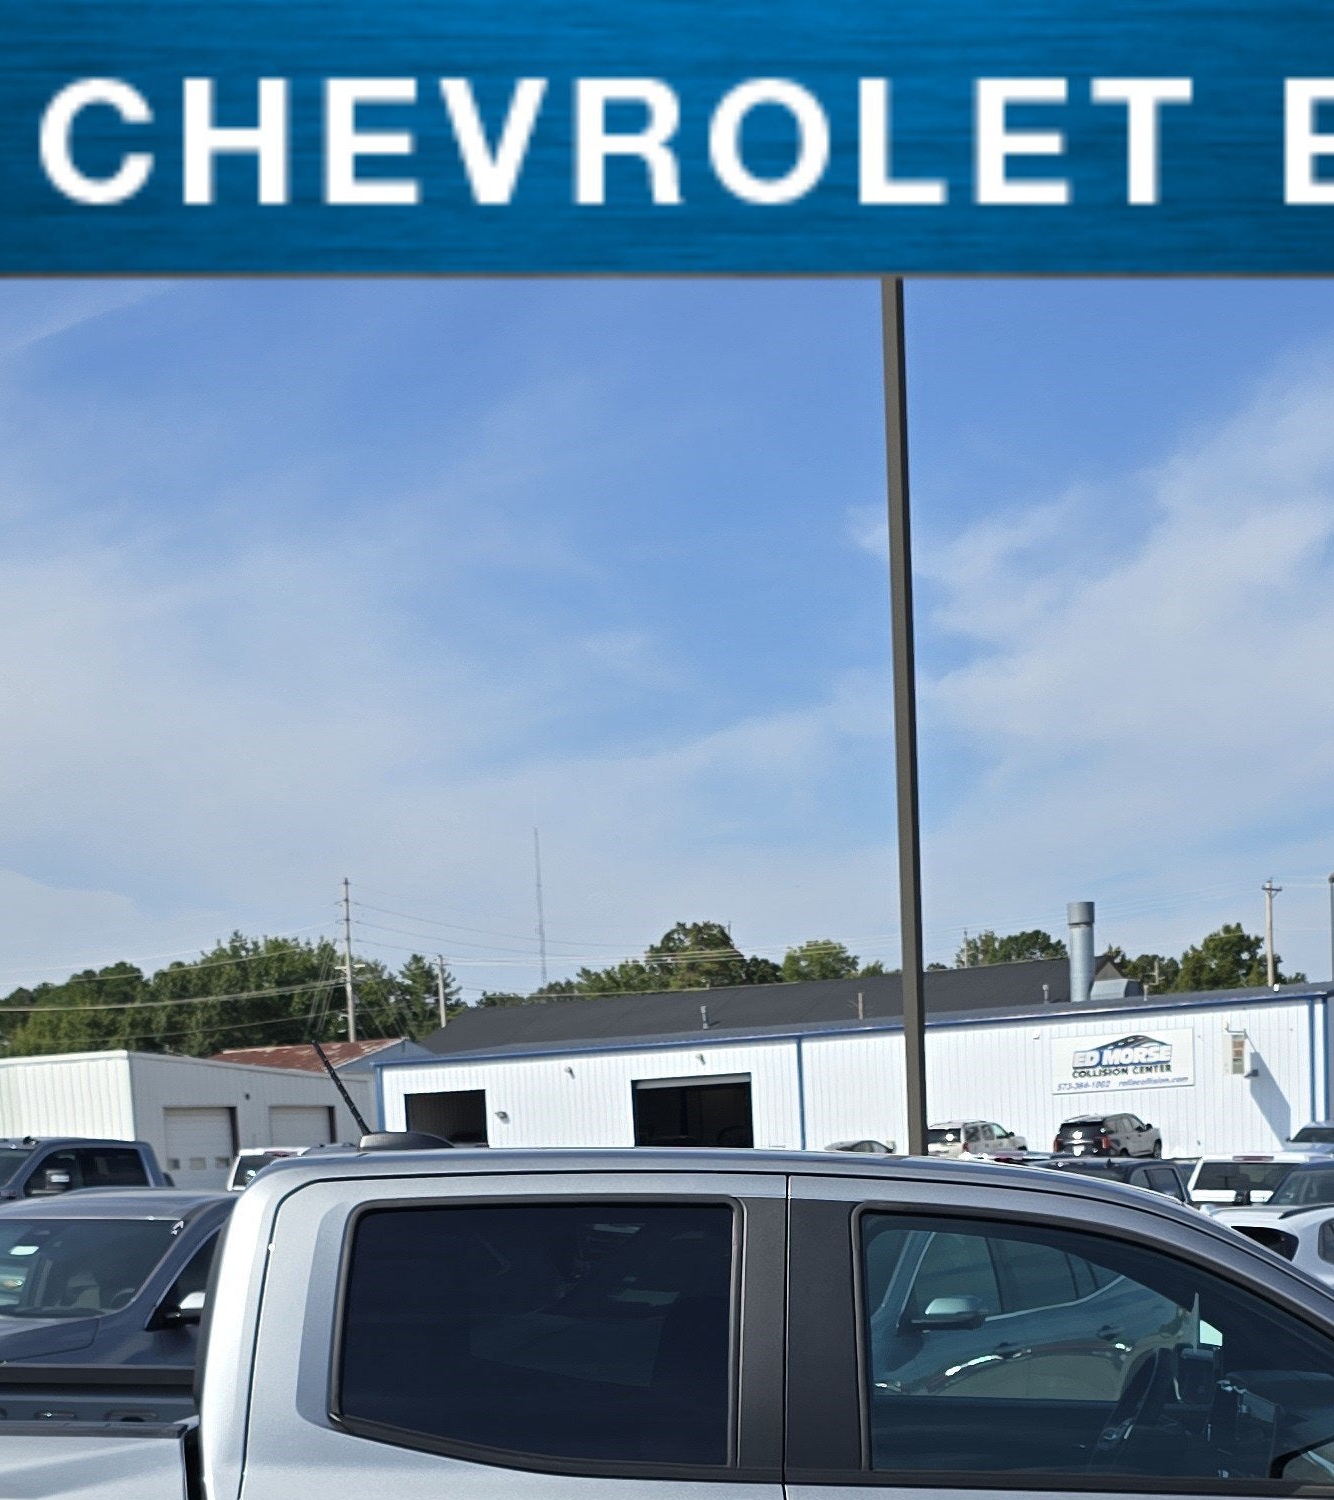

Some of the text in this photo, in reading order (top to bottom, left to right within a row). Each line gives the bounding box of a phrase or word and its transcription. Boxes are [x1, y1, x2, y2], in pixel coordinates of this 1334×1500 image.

[1072, 1044, 1172, 1069] ED MORSE
[1072, 1064, 1172, 1079] COLLISION CENTER
